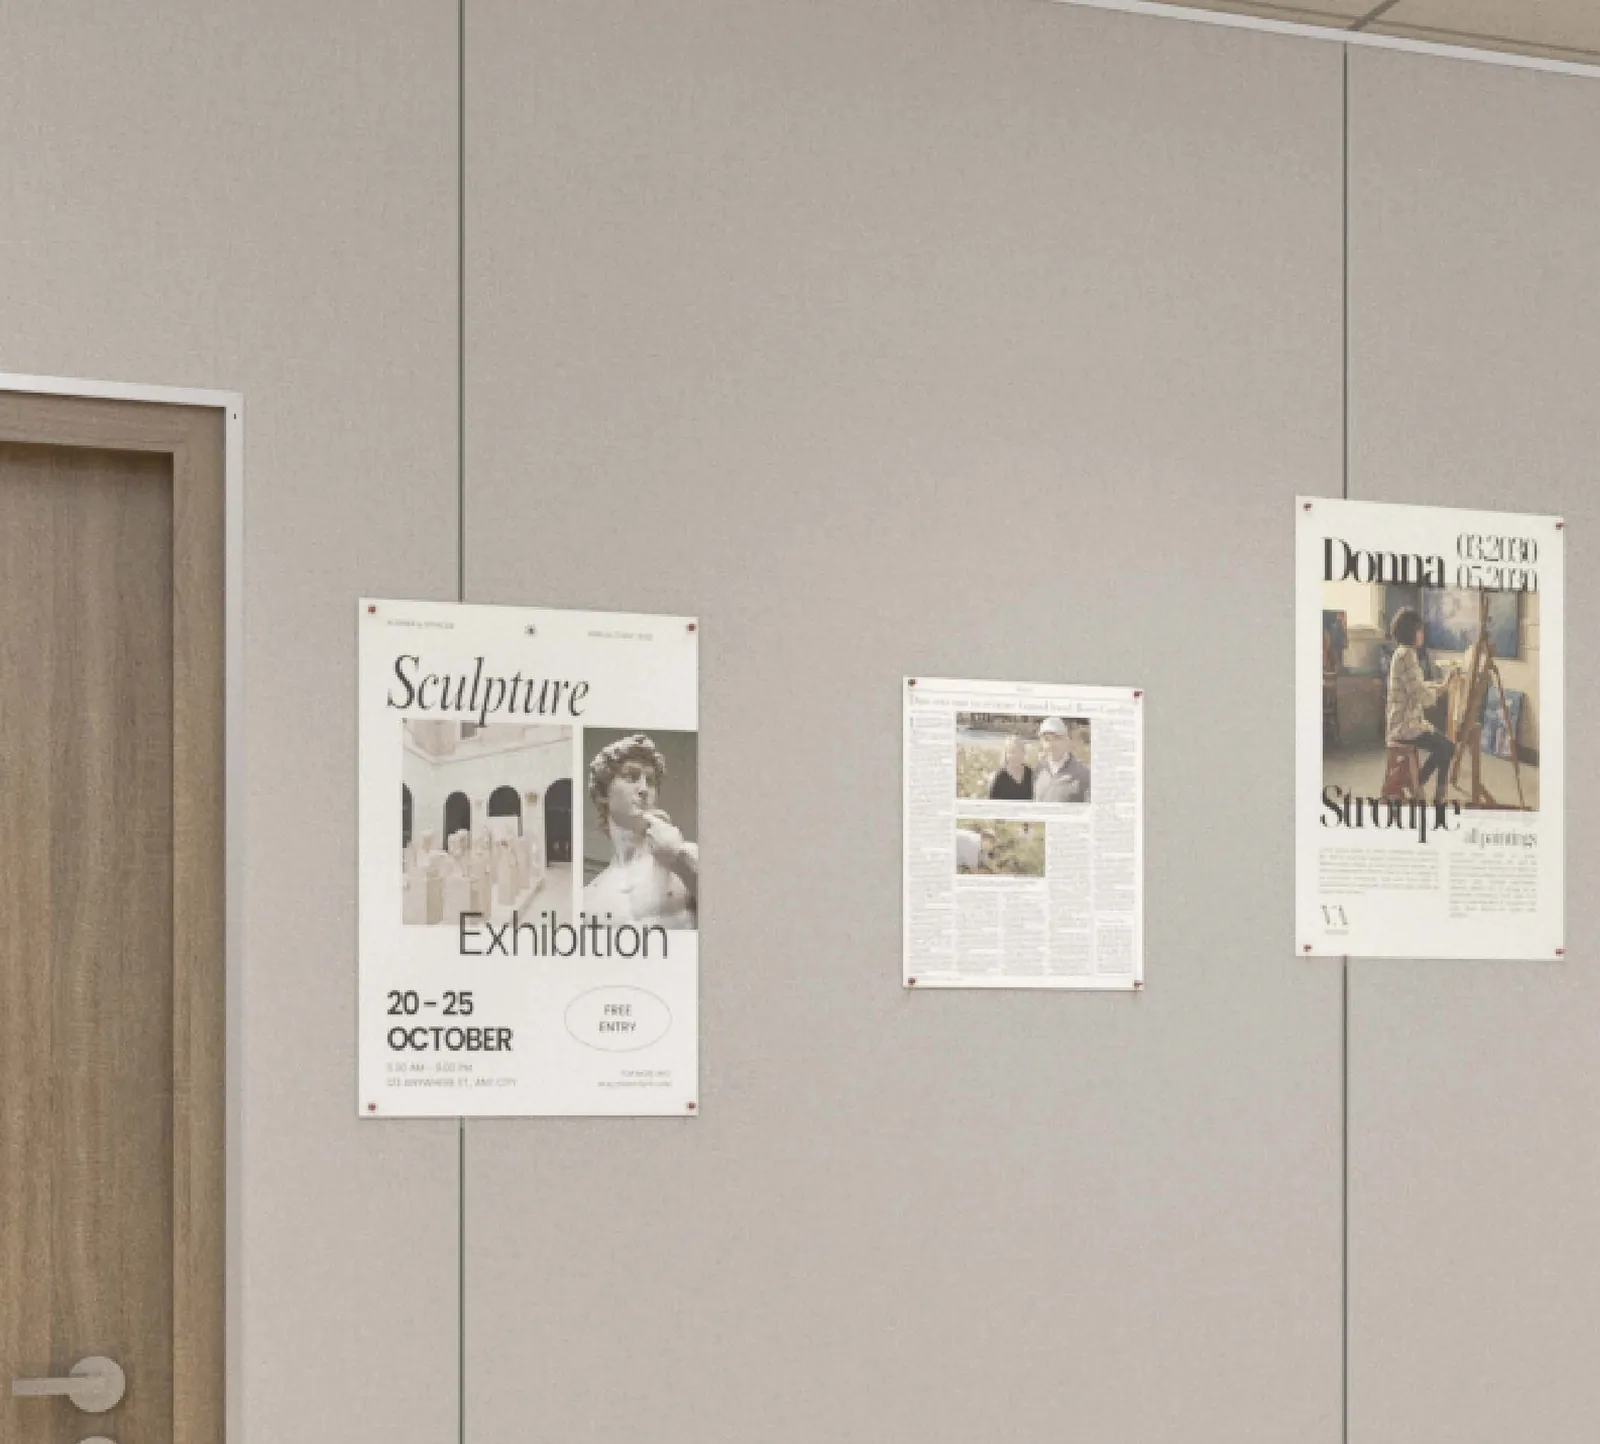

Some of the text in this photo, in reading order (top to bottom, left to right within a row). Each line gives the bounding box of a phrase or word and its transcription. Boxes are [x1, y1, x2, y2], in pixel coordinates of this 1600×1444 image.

[1320, 536, 1445, 588] Donna
[386, 653, 590, 728] Sculpture
[1319, 784, 1461, 844] Stroupe
[458, 910, 668, 959] Exhibition
[386, 990, 420, 1015] 20
[442, 990, 474, 1015] 25
[603, 1003, 632, 1017] FREE
[386, 1026, 514, 1052] OCTOBER
[598, 1020, 636, 1034] ENTRY
